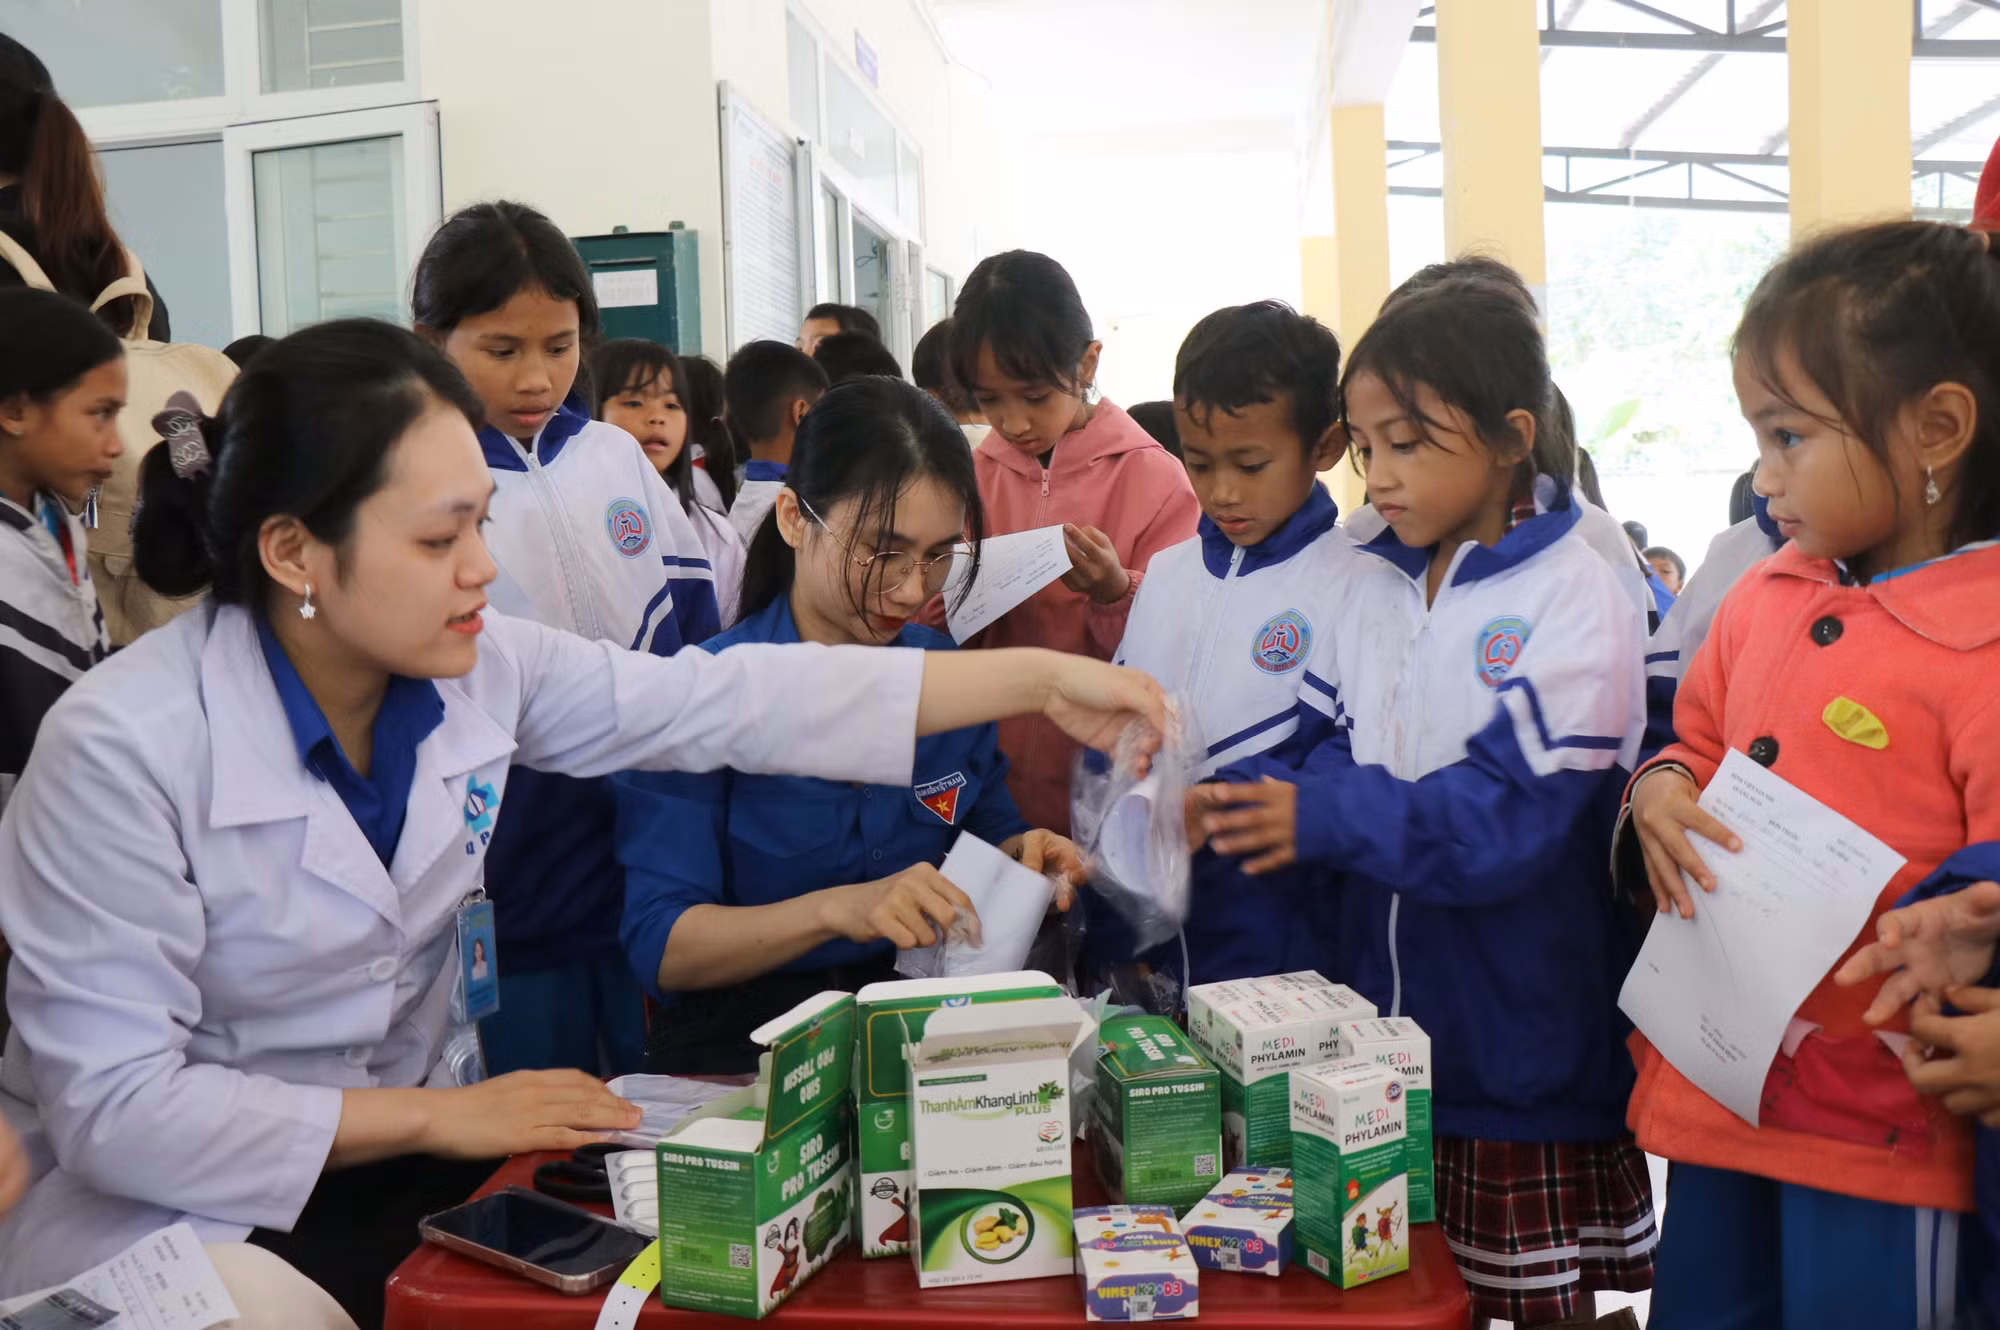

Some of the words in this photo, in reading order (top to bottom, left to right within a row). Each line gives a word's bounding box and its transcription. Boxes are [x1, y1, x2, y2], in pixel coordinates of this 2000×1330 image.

[1262, 1037, 1295, 1051] MEDI
[817, 1046, 835, 1070] PRO
[1251, 1048, 1306, 1064] PHYLAMIN
[1376, 1052, 1411, 1066] MEDI
[784, 1060, 815, 1094] TUSSIN
[800, 1077, 821, 1104] SIRO
[1129, 1088, 1151, 1098] SIRO
[1152, 1086, 1170, 1096] PRO
[1171, 1082, 1205, 1094] TUSSIN
[1301, 1090, 1326, 1109] MEDI
[1015, 1104, 1051, 1115] PLUS
[1294, 1101, 1334, 1127] PHYLAMIN
[1354, 1108, 1390, 1128] MEDI
[1345, 1120, 1402, 1146] PHYLAMIN
[800, 1134, 823, 1165] SIRO
[662, 1152, 684, 1164] SIRO
[685, 1154, 704, 1168] PRO
[706, 1158, 740, 1171] TUSSIN
[782, 1171, 805, 1202] PRO
[807, 1143, 840, 1184] TUSSIN
[1187, 1234, 1222, 1249] VIMEX
[1222, 1237, 1264, 1254] K2+D3
[1097, 1285, 1136, 1299] VIMEX
[1137, 1281, 1183, 1297] K2+D3
